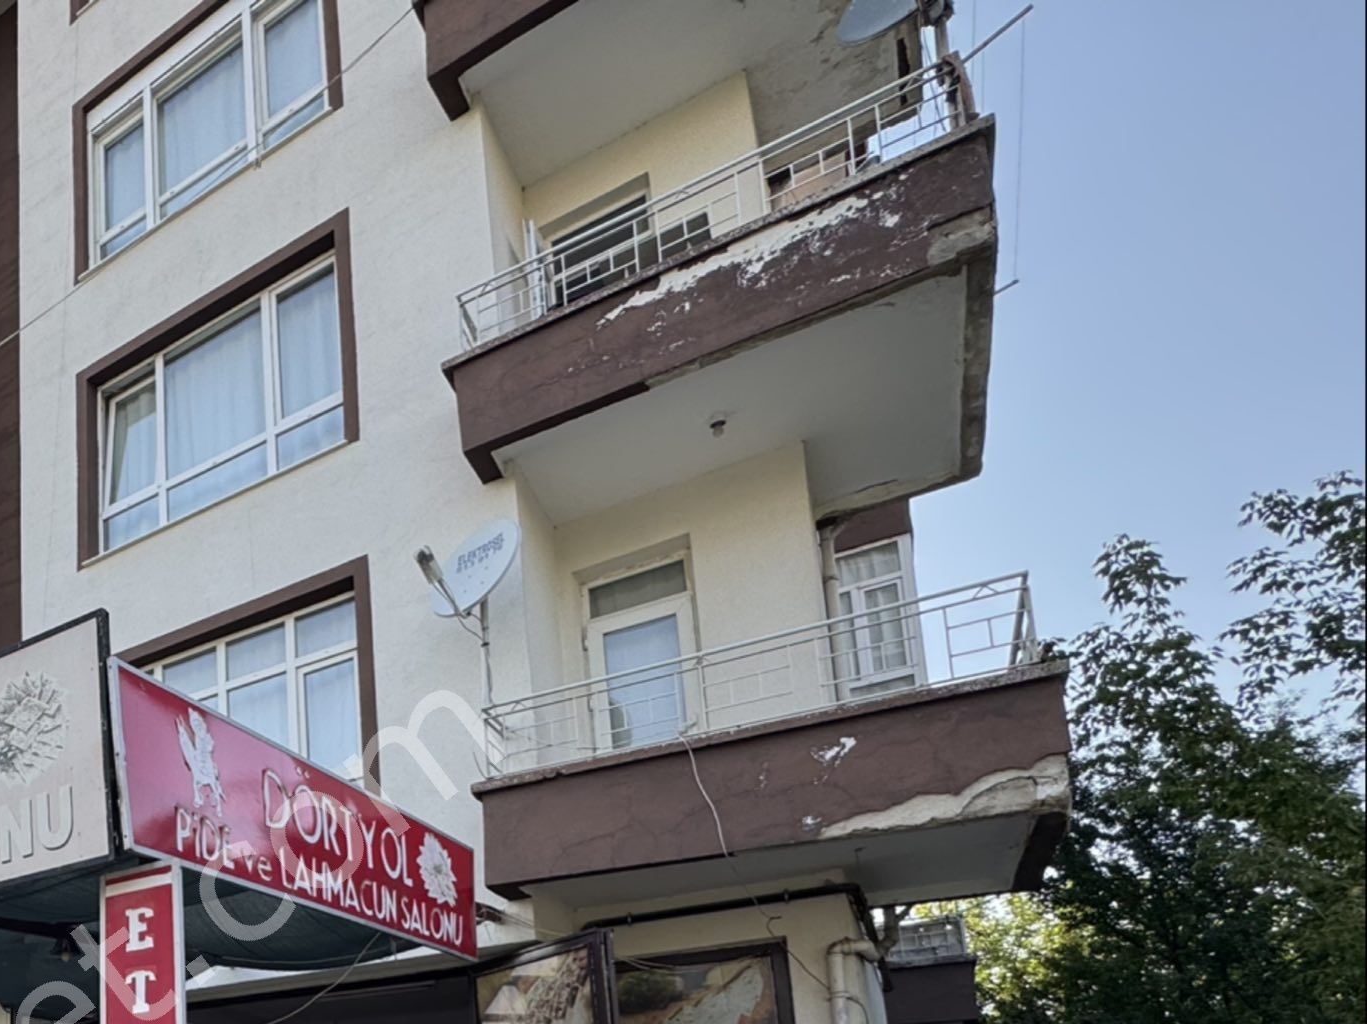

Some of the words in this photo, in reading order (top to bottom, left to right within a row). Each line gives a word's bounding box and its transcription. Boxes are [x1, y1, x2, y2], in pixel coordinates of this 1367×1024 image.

[262, 766, 414, 888] DÖRTYOL
[243, 849, 273, 882] ve
[279, 847, 398, 925] LAHMACUN
[400, 895, 464, 947] SALONU
